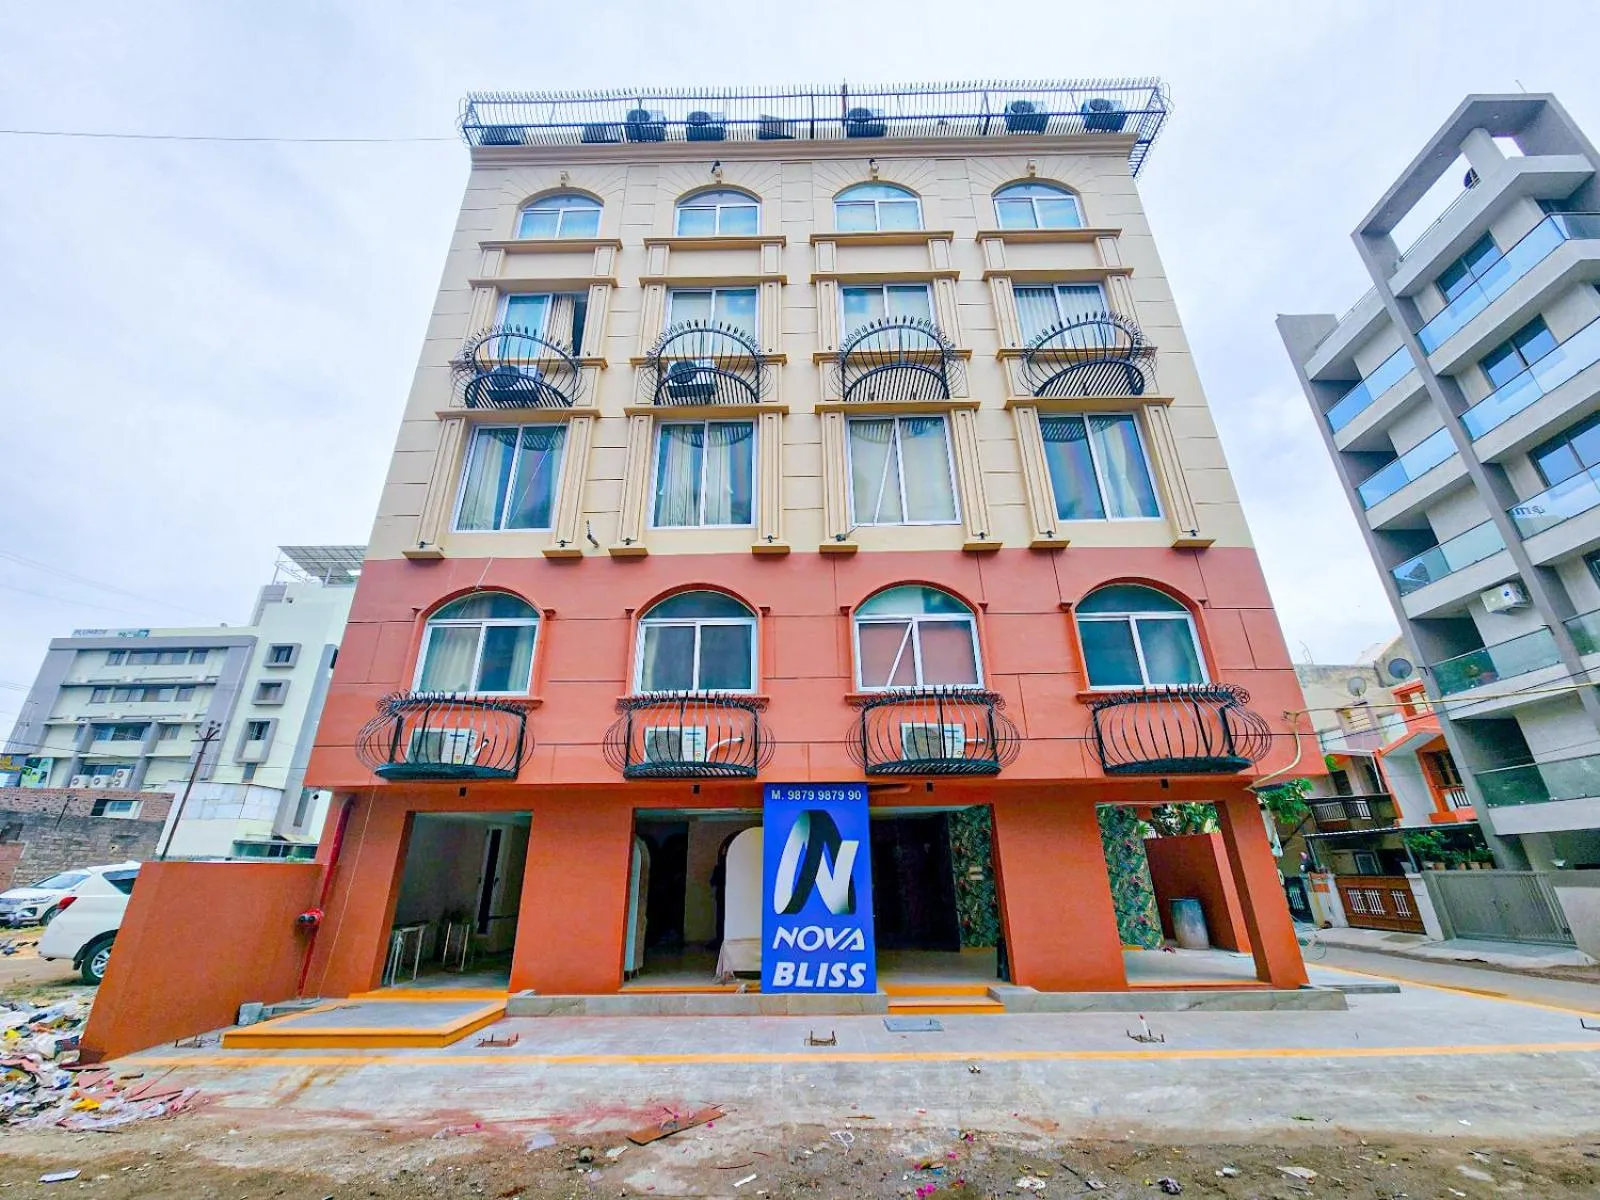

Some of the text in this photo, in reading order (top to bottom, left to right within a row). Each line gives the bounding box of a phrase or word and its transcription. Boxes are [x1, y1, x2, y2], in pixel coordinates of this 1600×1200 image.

[771, 790, 862, 800] M. 9879 9879 90
[772, 925, 865, 951] NOVA
[772, 961, 867, 989] BLISS
